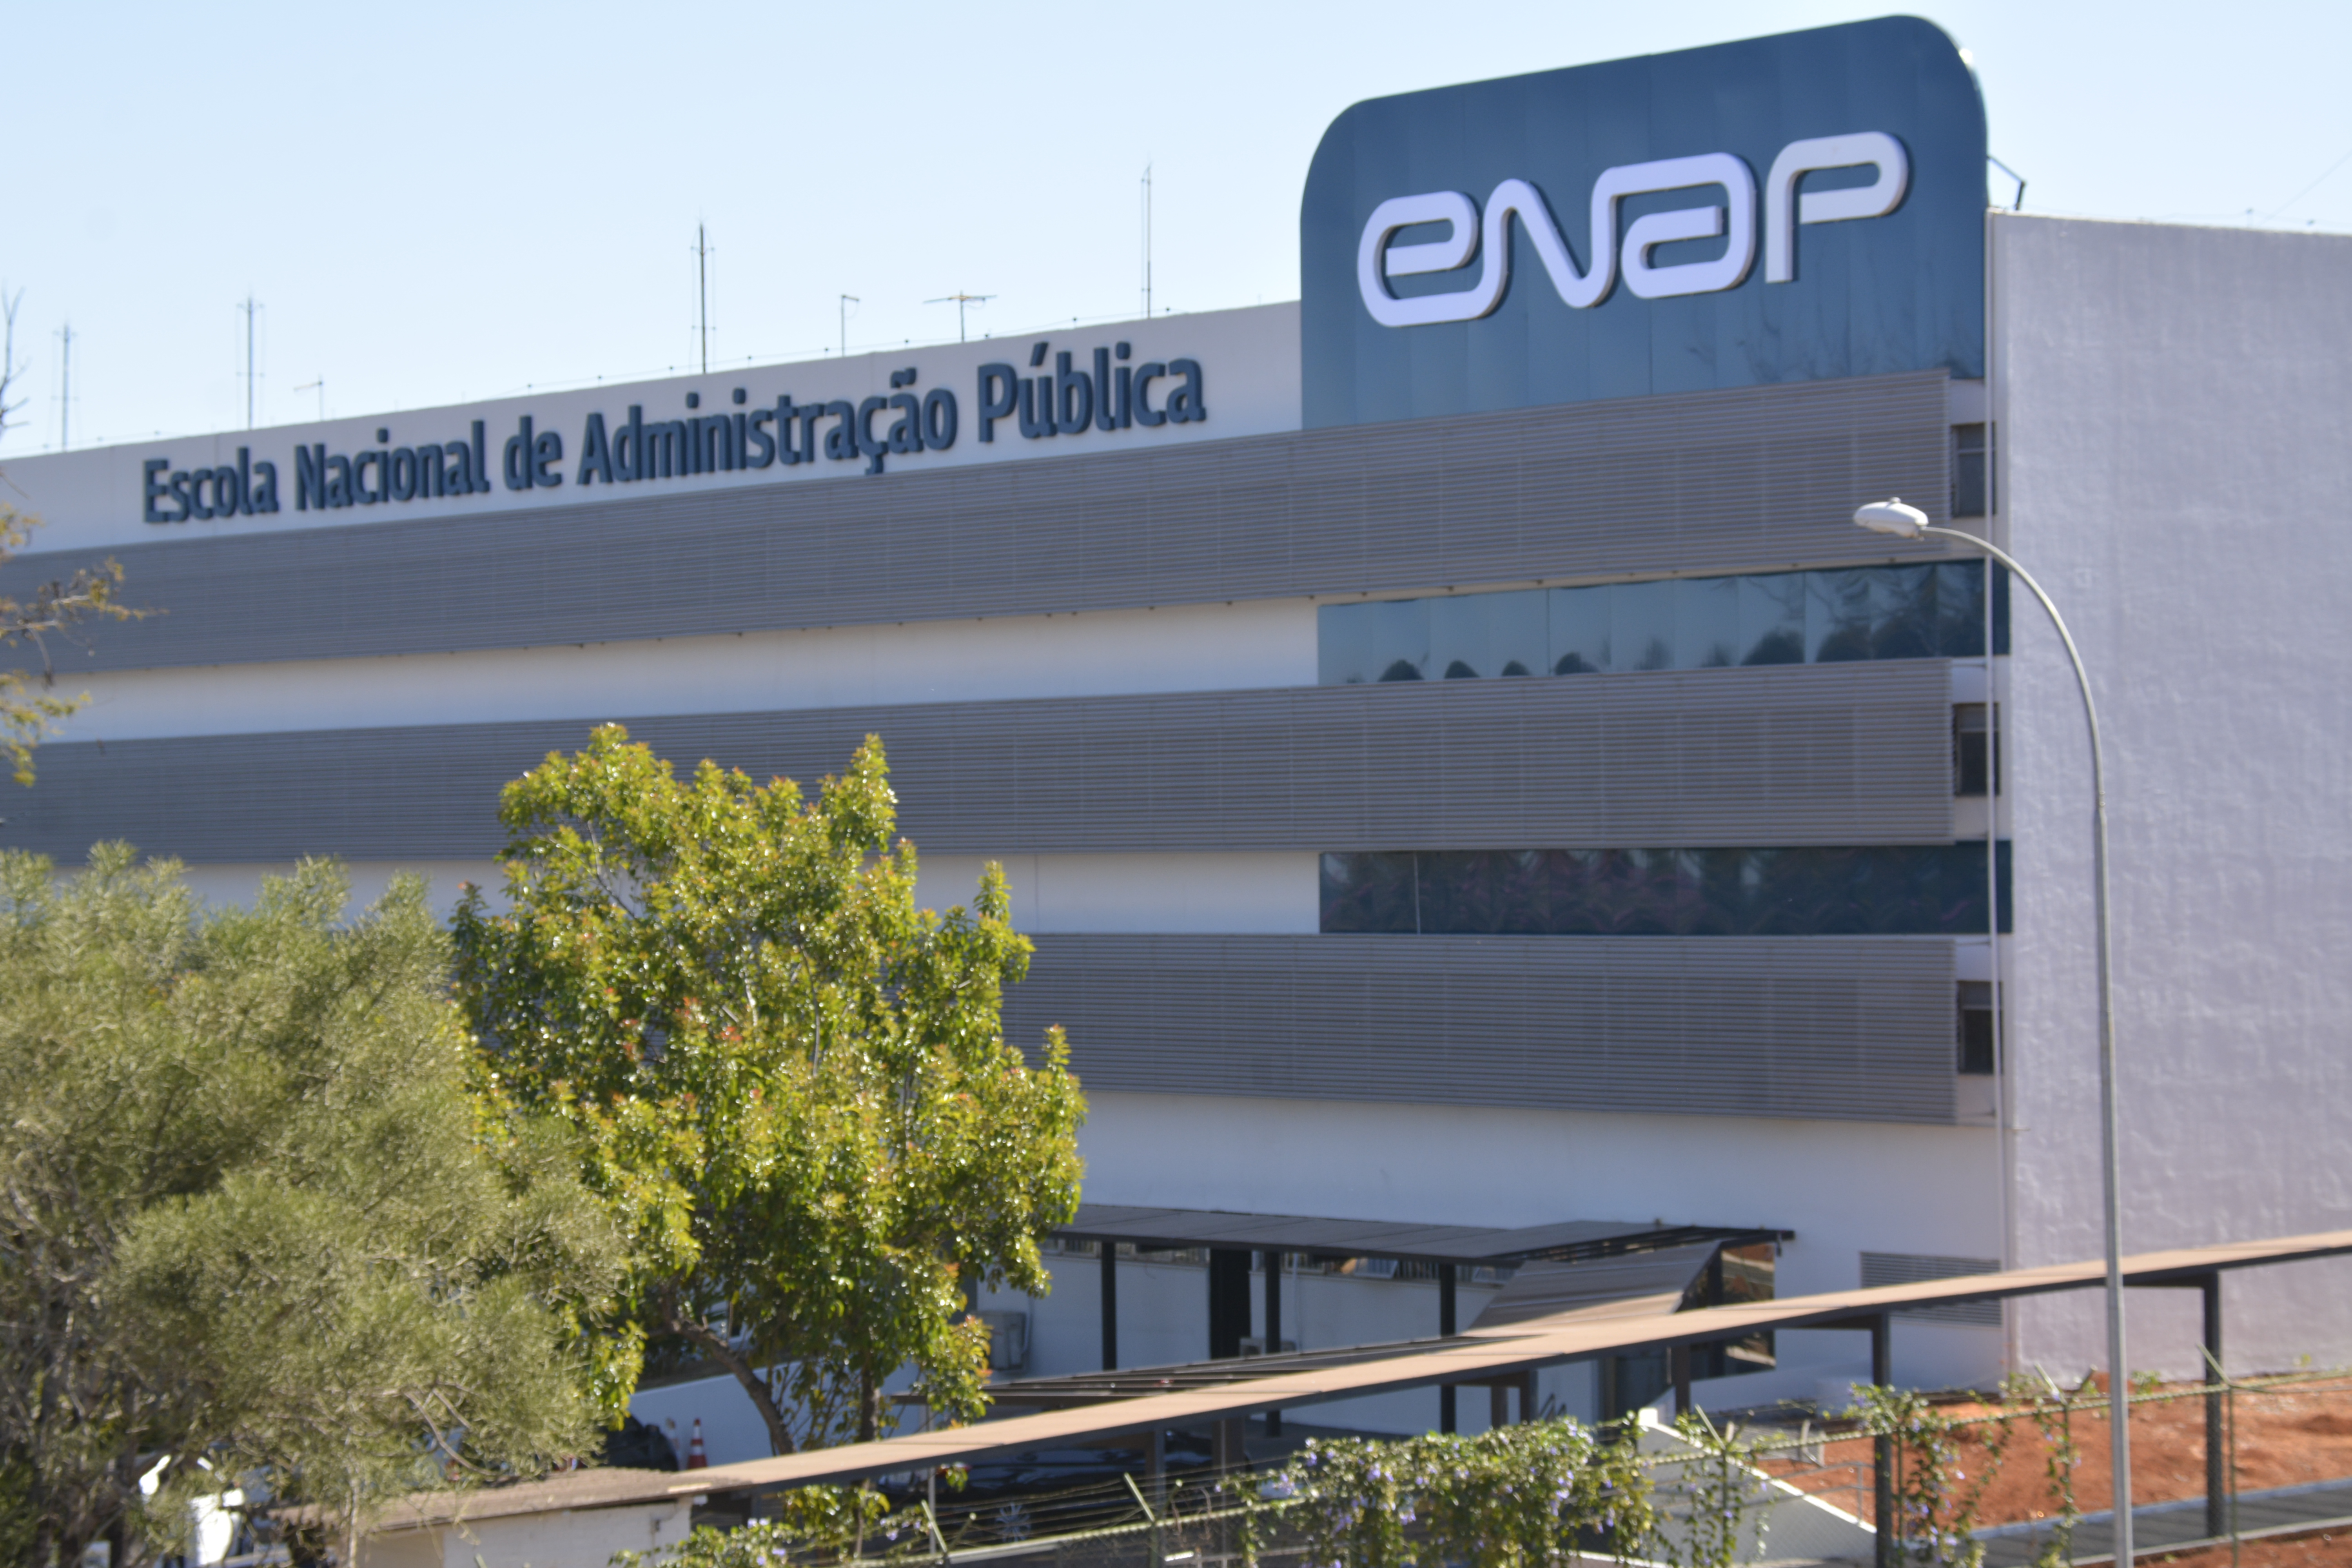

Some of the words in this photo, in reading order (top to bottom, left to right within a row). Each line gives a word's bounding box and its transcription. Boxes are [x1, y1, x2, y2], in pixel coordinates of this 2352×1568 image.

[143, 446, 279, 523] Escola
[295, 420, 490, 511] Nacional
[503, 415, 563, 491] de
[577, 367, 958, 485] Administração
[977, 341, 1206, 443] Pública
